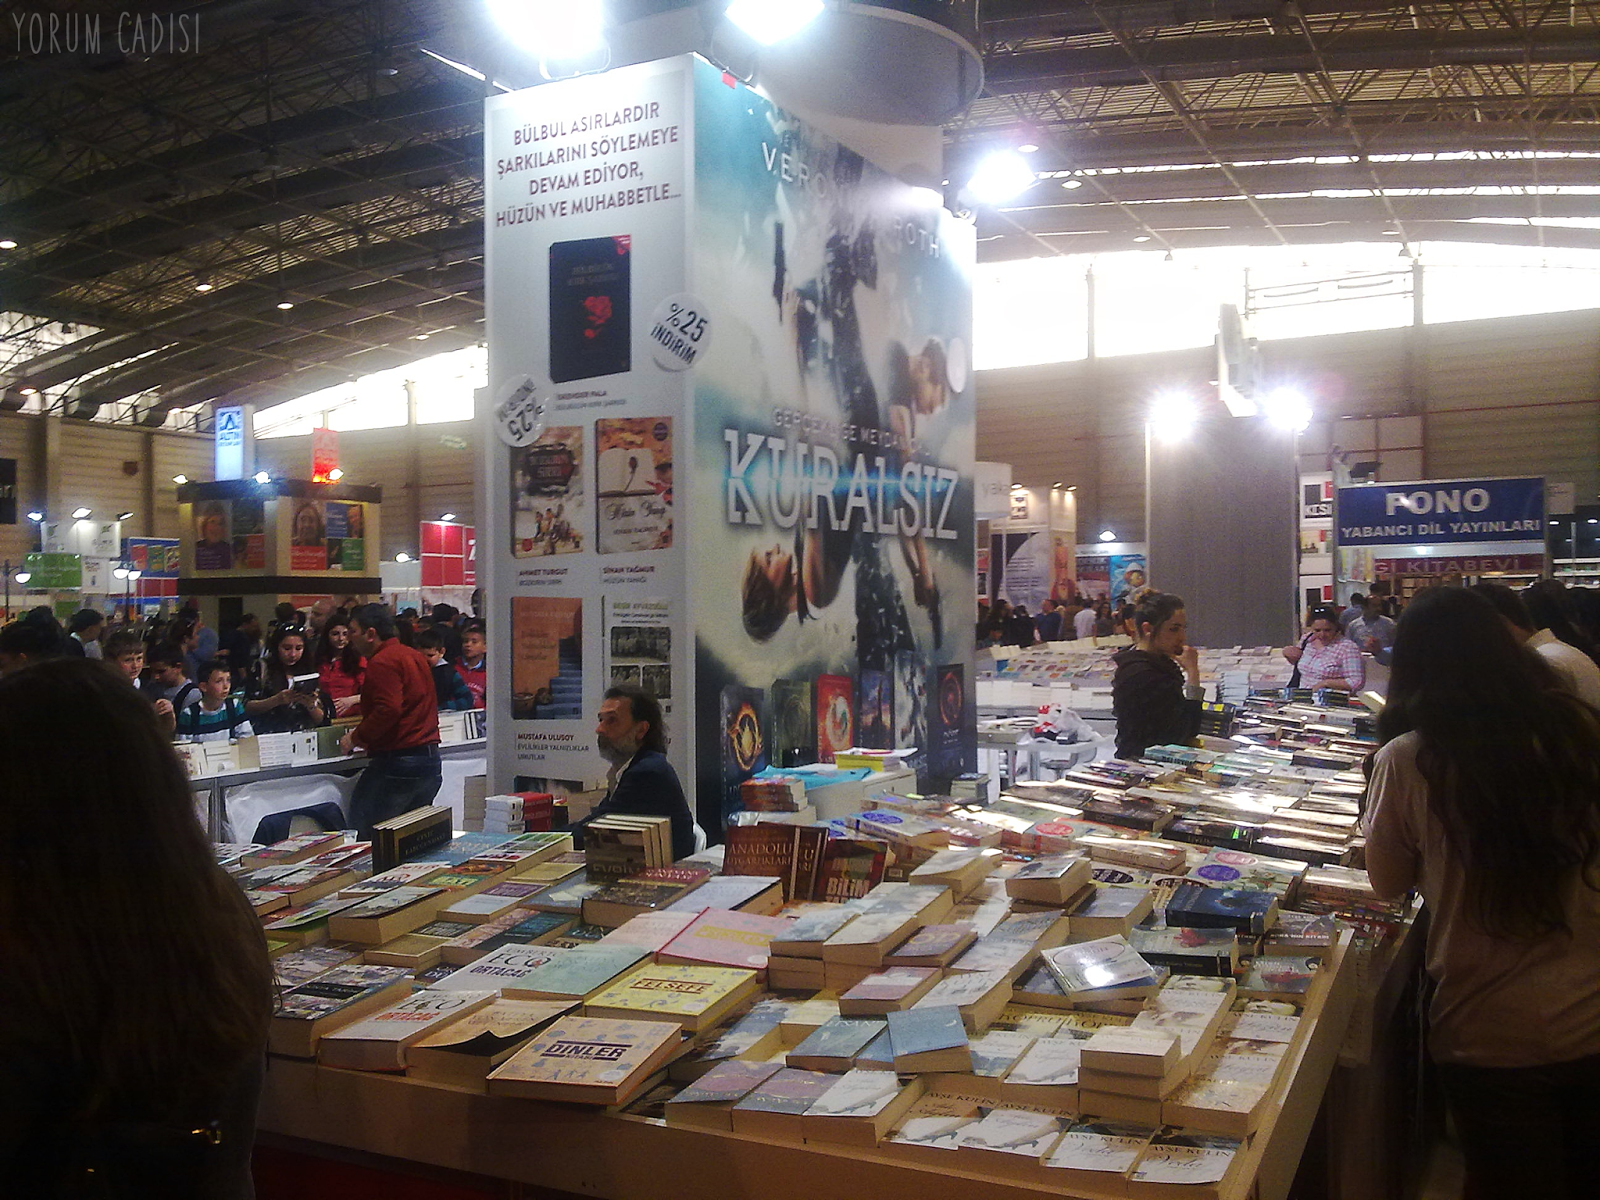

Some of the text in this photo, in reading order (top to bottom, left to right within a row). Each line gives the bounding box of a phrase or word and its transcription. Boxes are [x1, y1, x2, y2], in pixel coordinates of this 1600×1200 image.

[570, 102, 660, 134] ASIRLARDIR
[497, 126, 678, 180] ŞARKILARINI SÖYLEMEYE
[530, 174, 579, 195] DEVAM
[496, 203, 546, 227] HÜZÜN
[549, 201, 567, 217] VE
[666, 303, 708, 342] %25
[724, 429, 959, 539] KURALSIZ
[1386, 488, 1490, 516] FONO
[1341, 519, 1541, 538] YABANCI DİL YAYINLARI
[1406, 556, 1520, 573] KİTABEVİ
[729, 842, 792, 856] ANADOLU
